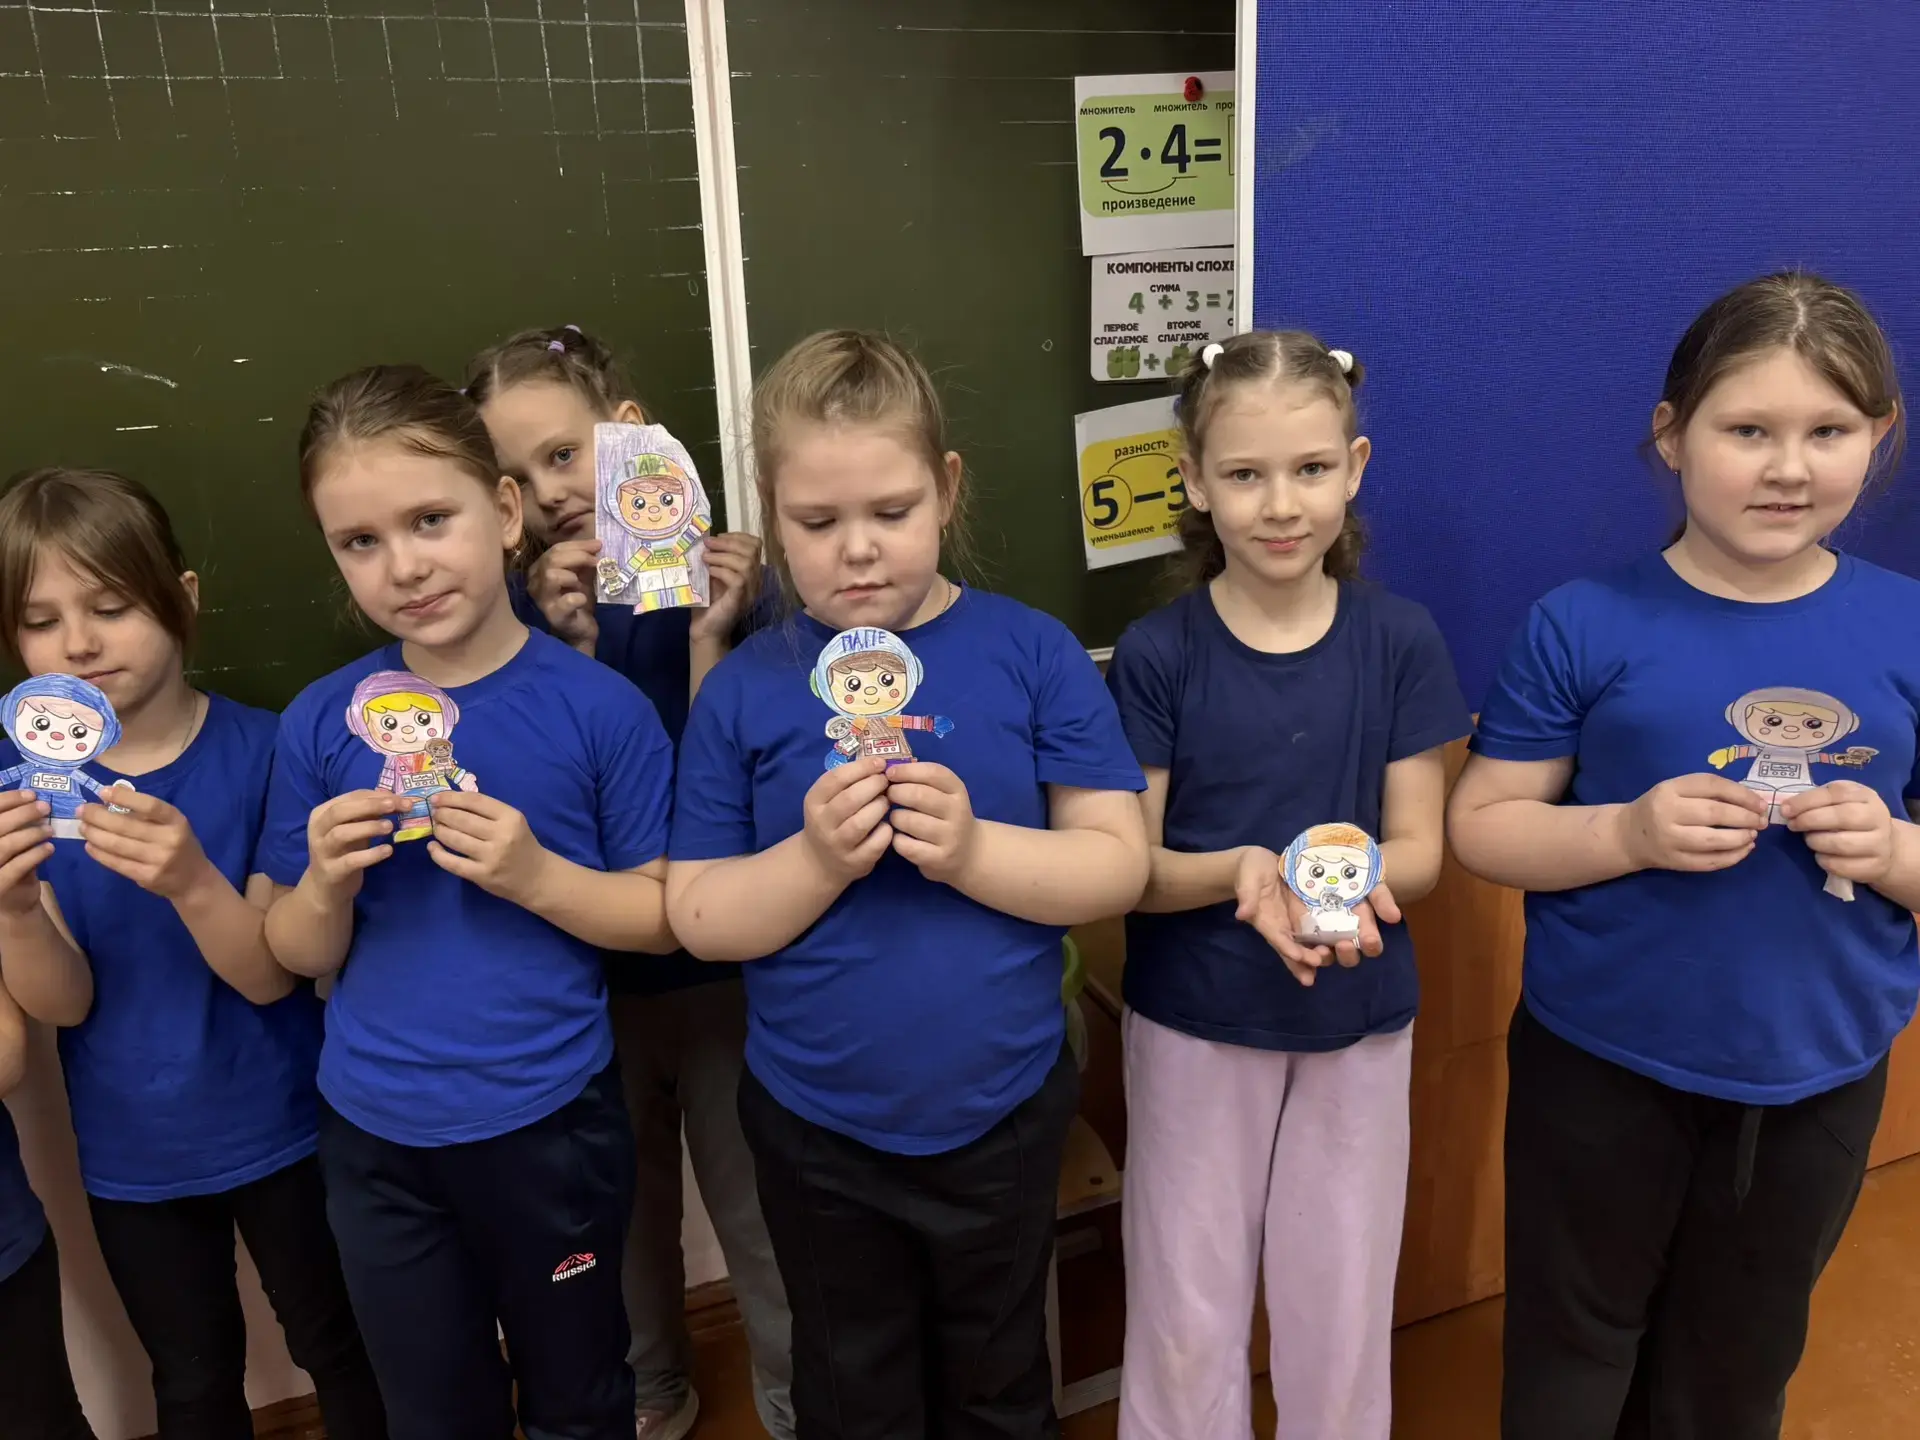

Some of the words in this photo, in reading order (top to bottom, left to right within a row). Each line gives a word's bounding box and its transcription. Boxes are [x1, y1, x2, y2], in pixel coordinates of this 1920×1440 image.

[1080, 106, 1136, 115] множитель
[1153, 103, 1208, 113] множитель
[1215, 102, 1235, 111] про
[1099, 127, 1128, 177] 2
[1102, 195, 1196, 212] произведение
[1107, 261, 1194, 274] КОМПОНЕНТЫ
[1150, 284, 1180, 292] СУММА
[1128, 292, 1145, 314] 4
[1185, 290, 1199, 312] 3
[1104, 323, 1139, 332] ПЕРВОЕ
[1167, 321, 1201, 330] ВТОРОЕ
[1094, 335, 1148, 345] СЛАГАЕМОЕ
[1158, 332, 1209, 343] СЛАГАЕМОЕ
[1114, 439, 1169, 460] разность
[1090, 525, 1155, 546] уменьшаемое
